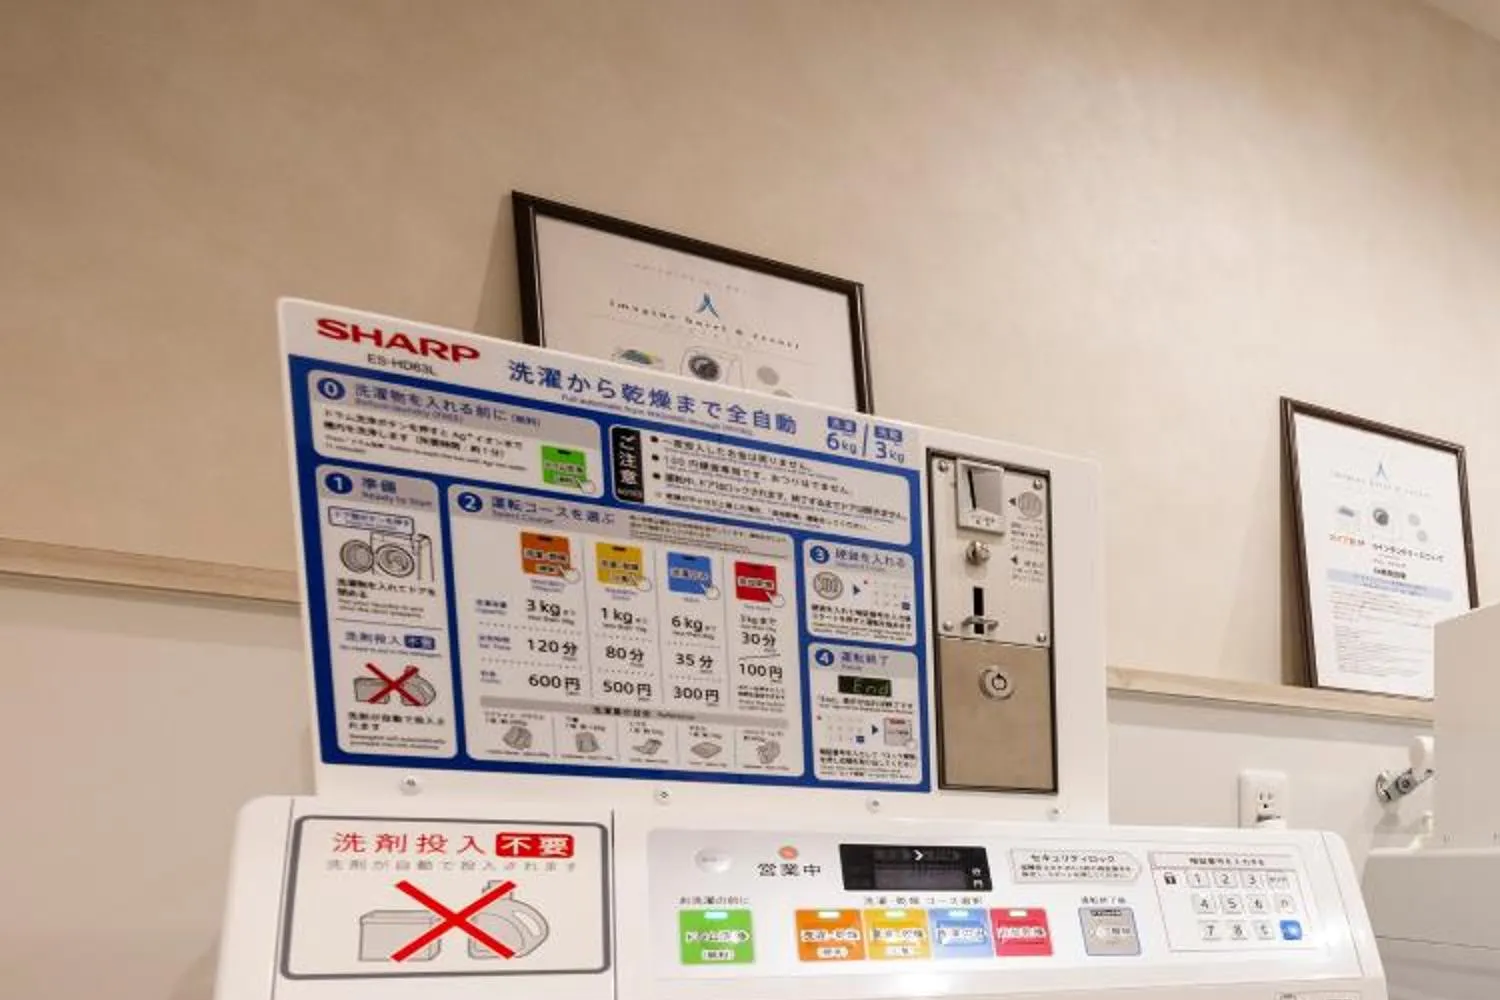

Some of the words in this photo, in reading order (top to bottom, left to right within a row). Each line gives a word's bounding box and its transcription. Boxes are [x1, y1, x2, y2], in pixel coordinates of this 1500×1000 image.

[316, 317, 480, 363] SHARP
[508, 359, 798, 436] 洗濯から乾燥まで全自動
[491, 495, 615, 524] 運転コースを選ぶ
[527, 599, 536, 612] 3
[540, 600, 561, 617] kg
[613, 608, 633, 624] kg
[671, 615, 681, 627] 6
[684, 616, 703, 632] kg
[527, 638, 579, 656] 120分
[741, 632, 776, 647] 30分
[605, 646, 644, 663] 80分
[675, 653, 714, 669] 35分
[819, 652, 830, 664] 4
[739, 664, 783, 680] 100円
[528, 674, 581, 692] 600円
[603, 681, 652, 697] 500円
[852, 677, 890, 695] End
[673, 686, 719, 703] 300円
[332, 831, 486, 856] 洗剤投入
[499, 834, 572, 857] 不要
[326, 858, 577, 873] 洗剤が自動で投入されます
[757, 862, 822, 878] 営業中
